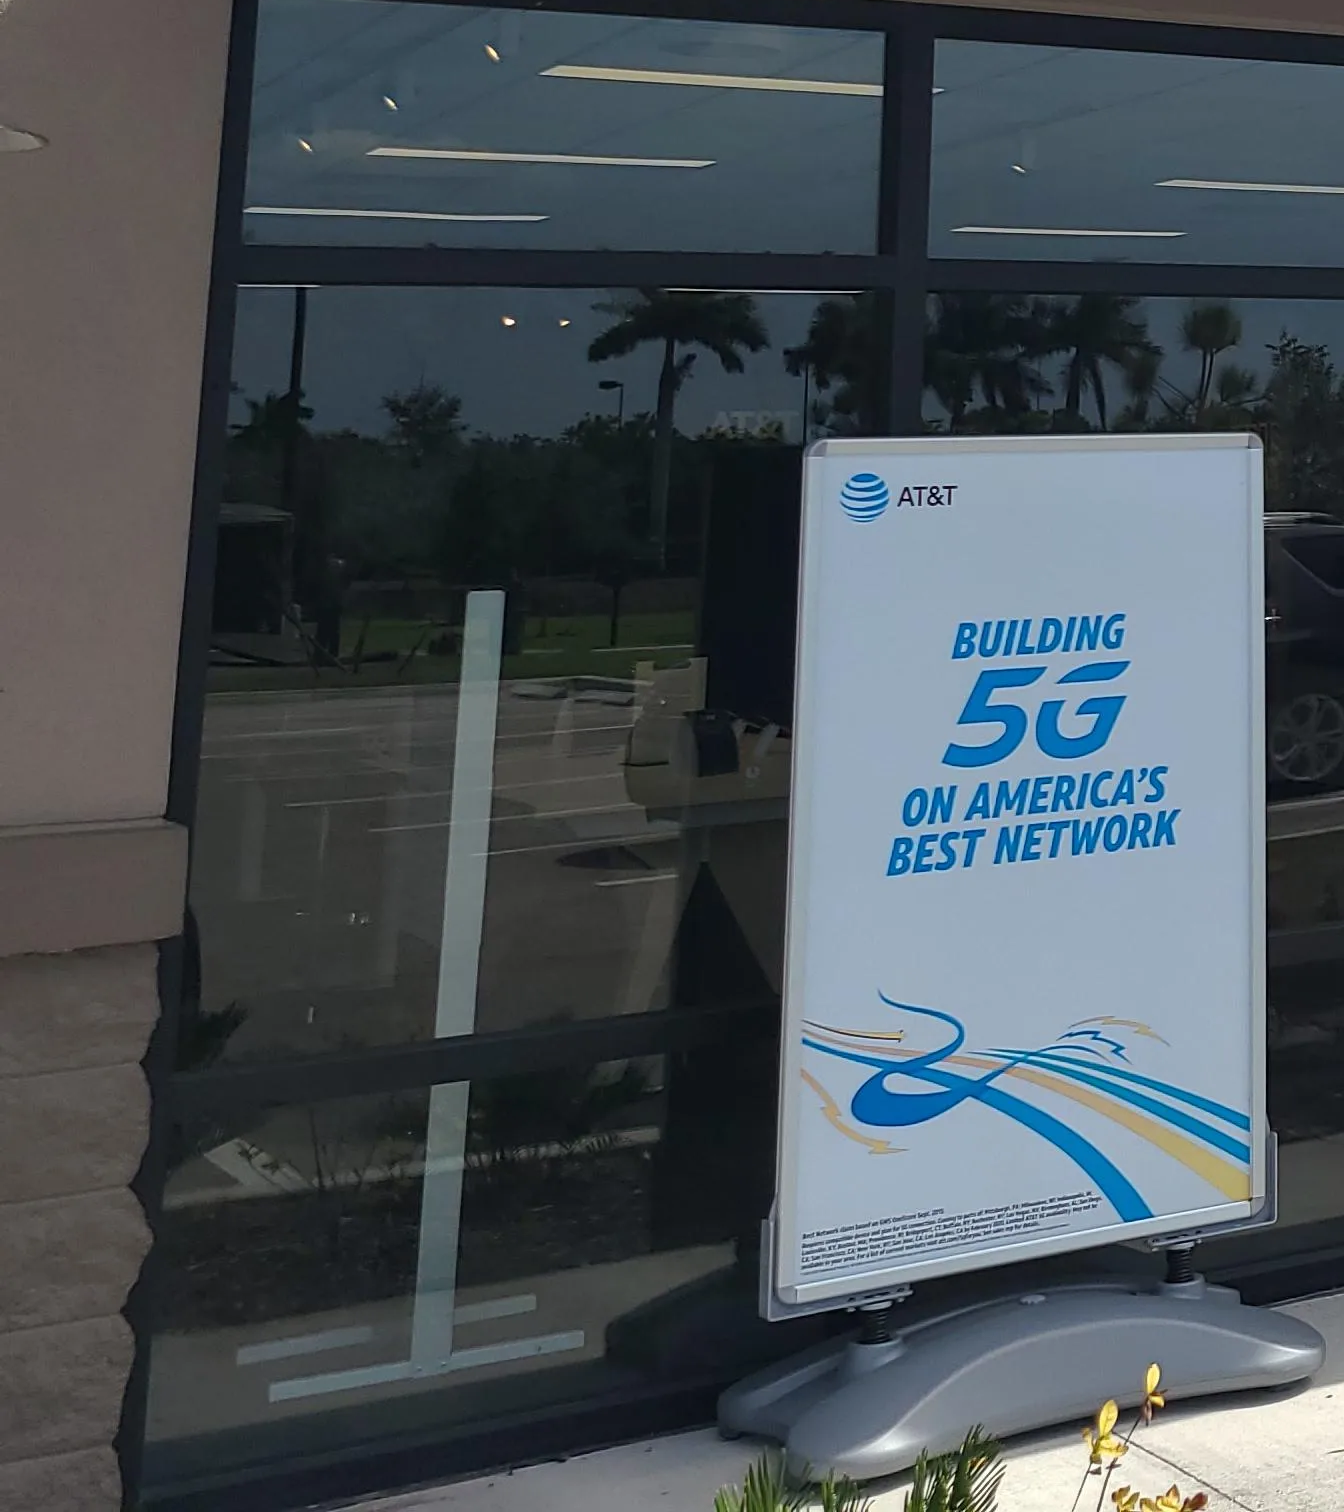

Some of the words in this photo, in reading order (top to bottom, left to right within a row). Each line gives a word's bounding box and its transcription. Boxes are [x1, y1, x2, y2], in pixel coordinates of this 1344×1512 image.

[897, 486, 958, 507] AT&T
[951, 613, 1126, 660] BUILDING
[942, 661, 1131, 769] 5G
[901, 785, 958, 828] ON
[964, 765, 1169, 821] AMERICA'S
[885, 828, 987, 877] BEST
[993, 808, 1181, 865] NETWORK
